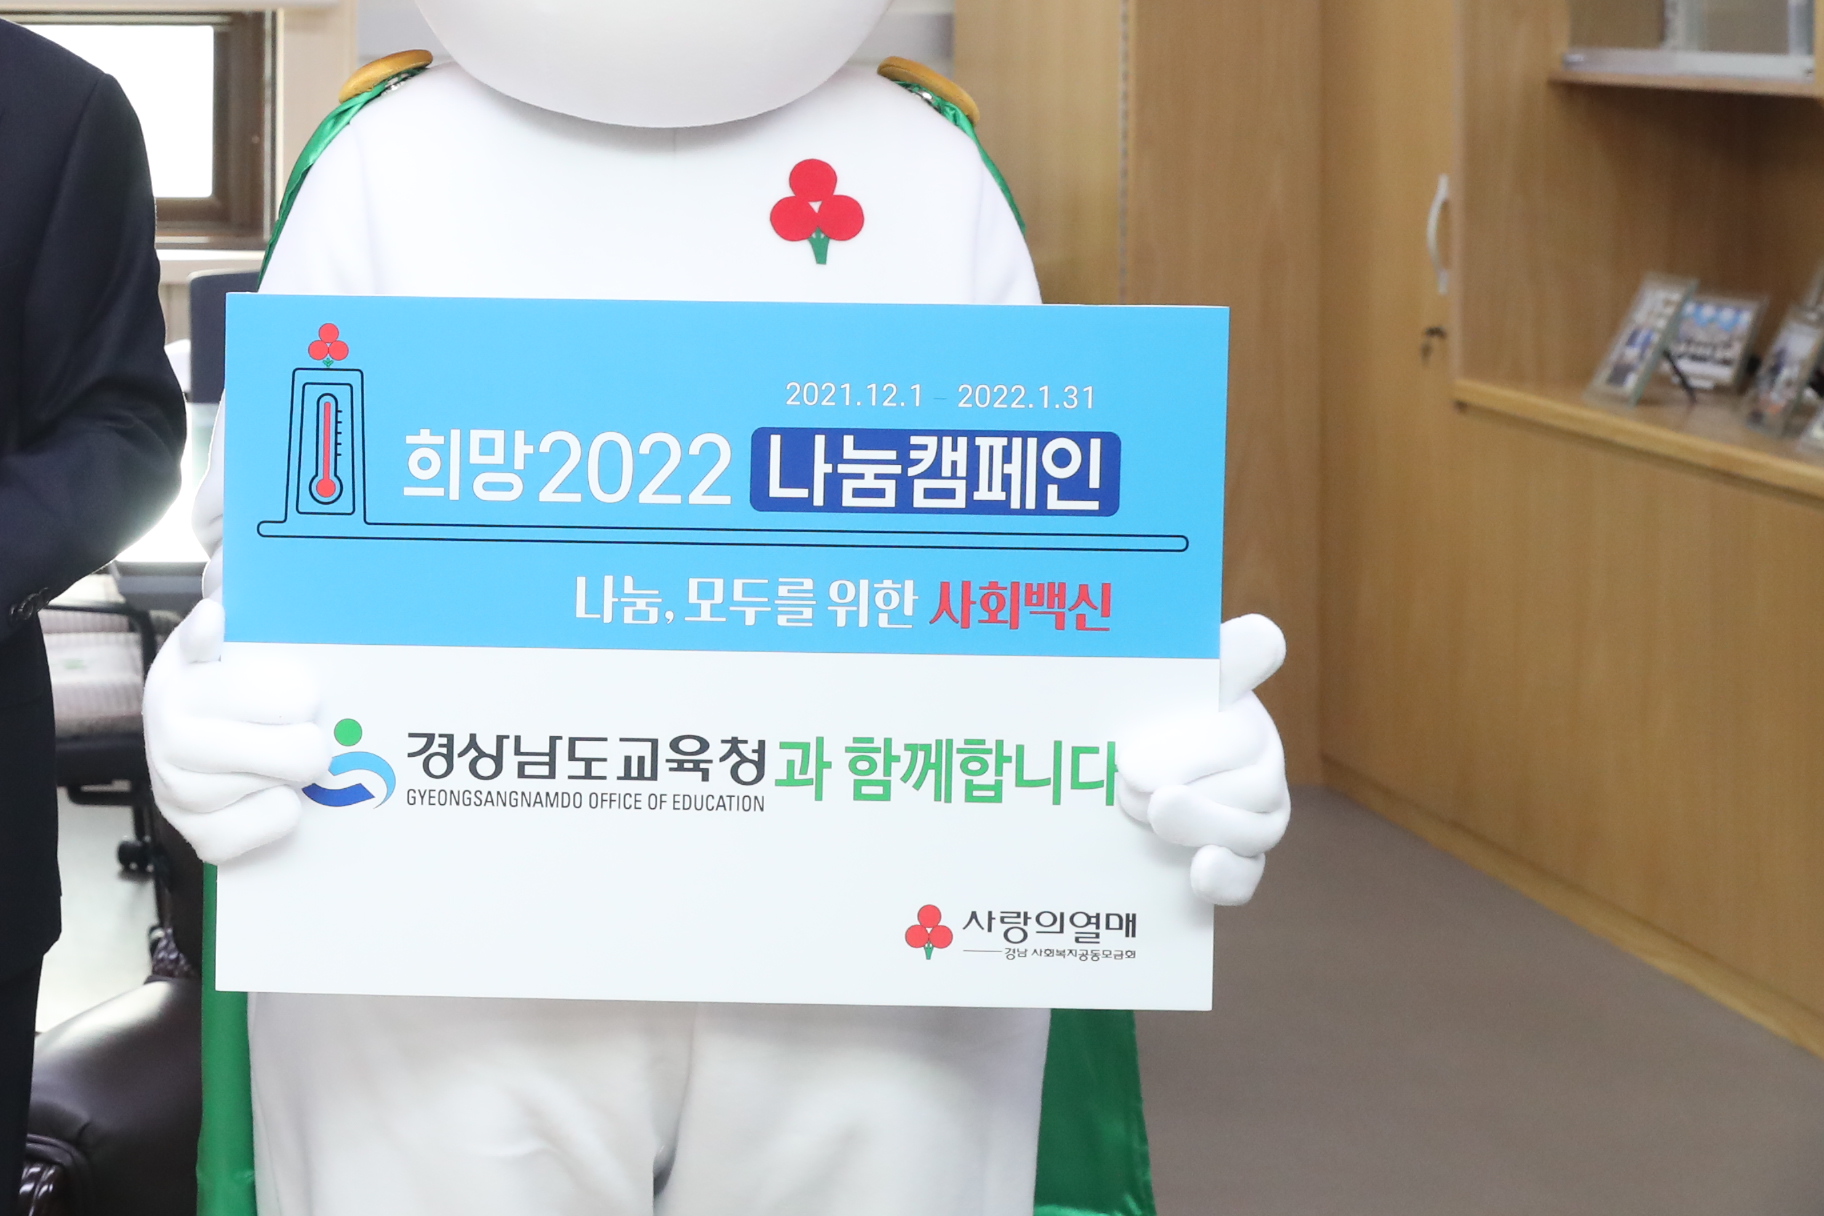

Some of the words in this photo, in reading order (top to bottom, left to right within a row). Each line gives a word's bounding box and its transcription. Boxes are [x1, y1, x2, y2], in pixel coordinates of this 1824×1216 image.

[786, 381, 922, 407] 2021.12.1
[957, 384, 1095, 410] 2022.1.31
[403, 428, 733, 505] 희망2022
[769, 434, 1103, 511] 나눔캠페인
[684, 577, 818, 628] 모두를
[828, 579, 919, 630] 위한
[929, 580, 1112, 633] 사회백신
[845, 736, 1120, 807] 함께합니다
[406, 788, 584, 810] GYEONGSANGNAMDO
[588, 791, 643, 811] OFFICE
[647, 793, 668, 811] OF
[672, 794, 766, 813] EDUCATION
[962, 910, 1137, 944] 사랑의열매
[1004, 947, 1028, 961] 경남
[1031, 947, 1137, 962] 사회복지공동모금회
